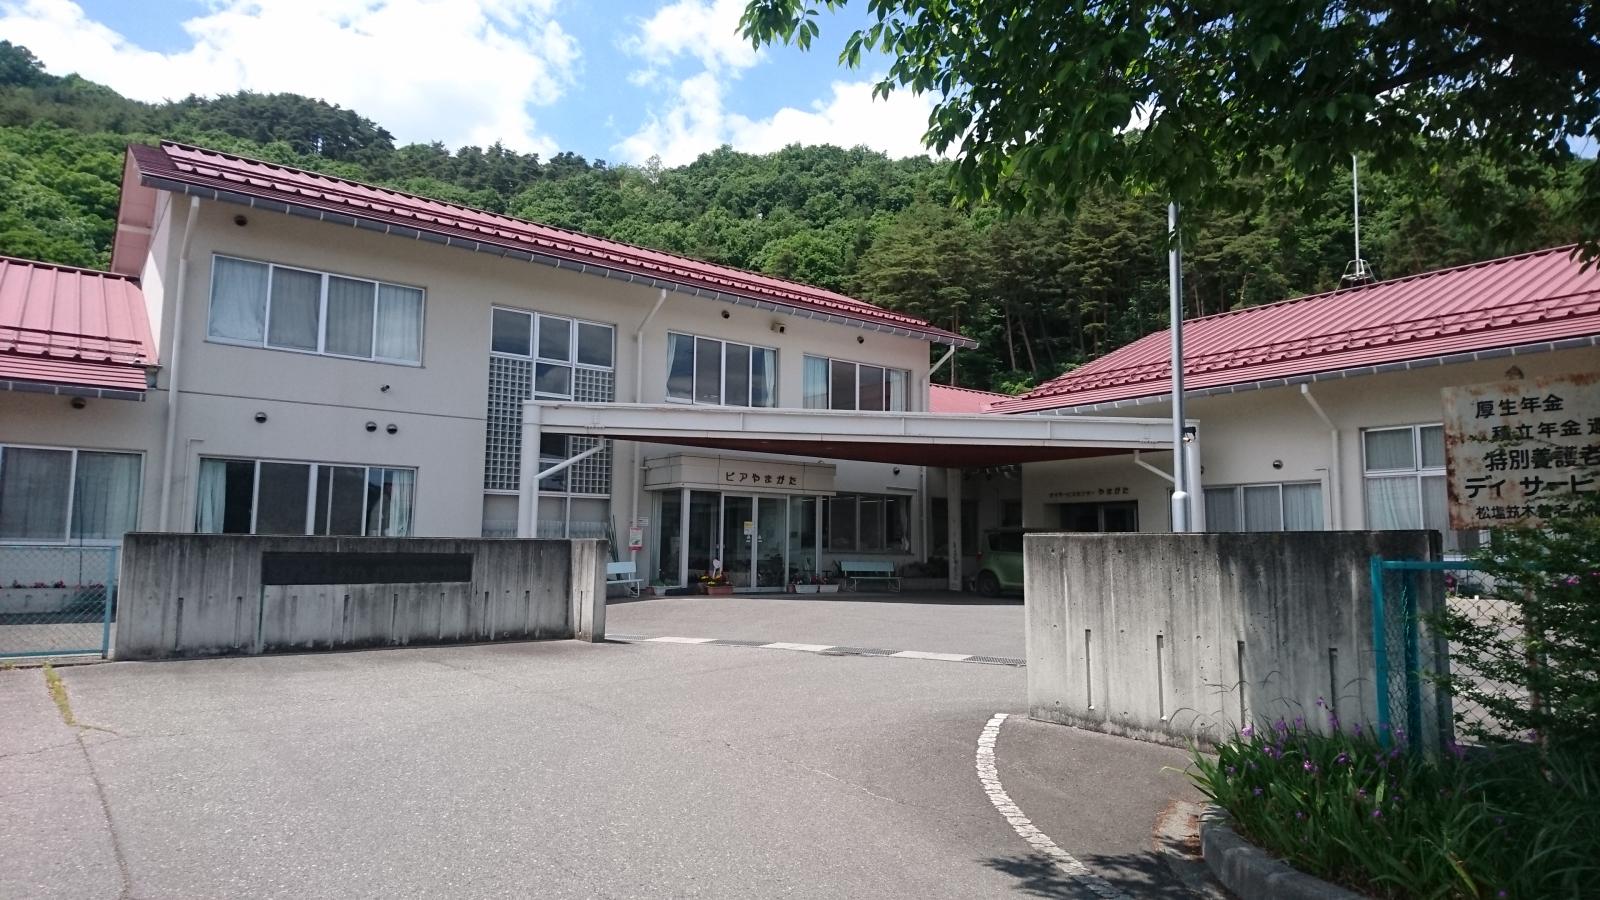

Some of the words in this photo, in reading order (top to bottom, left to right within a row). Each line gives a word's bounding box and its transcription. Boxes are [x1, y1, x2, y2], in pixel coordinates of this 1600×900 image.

[1475, 394, 1564, 419] 厚生年金
[725, 471, 797, 486] ピアやまがた
